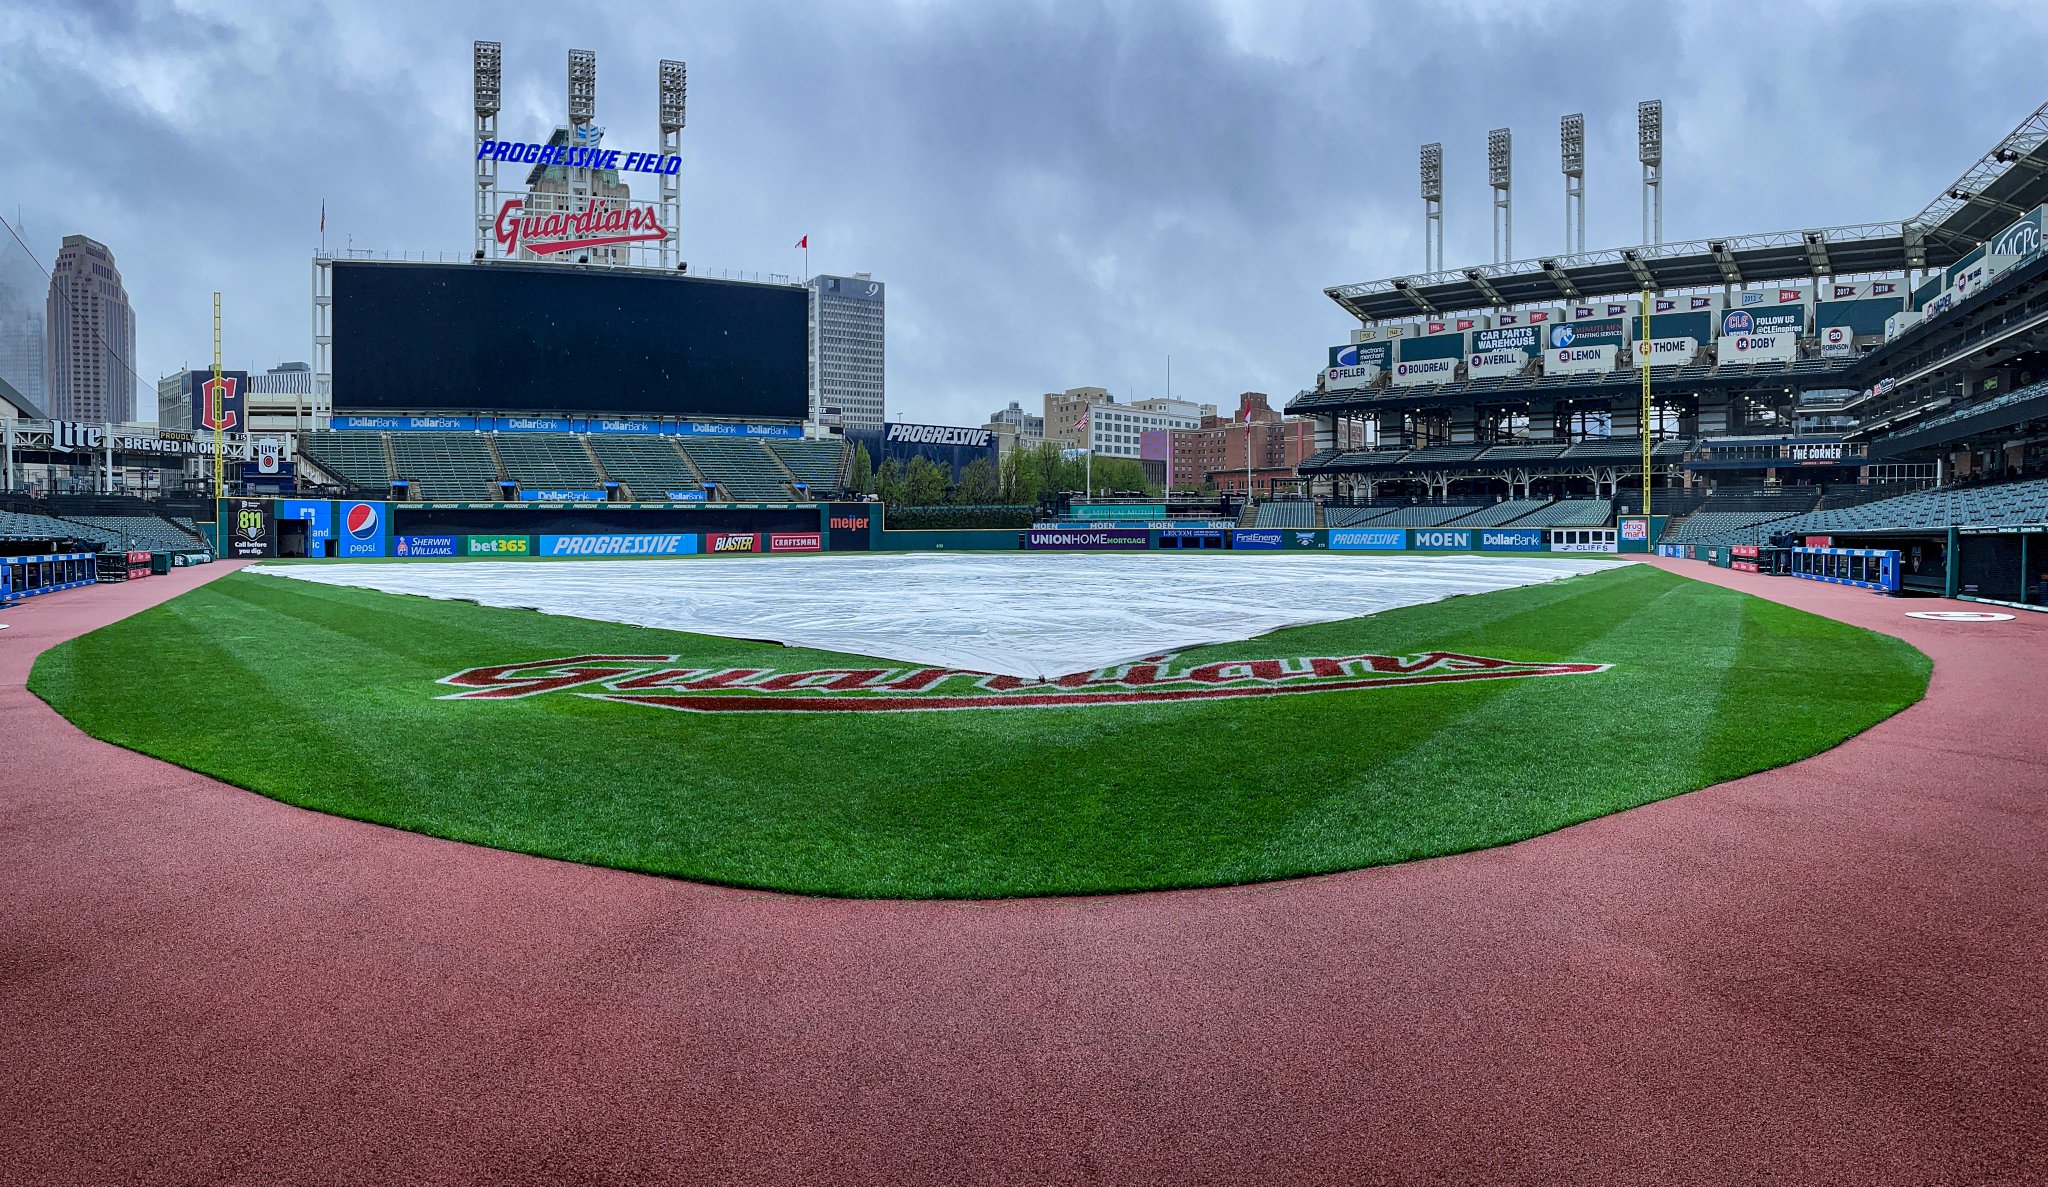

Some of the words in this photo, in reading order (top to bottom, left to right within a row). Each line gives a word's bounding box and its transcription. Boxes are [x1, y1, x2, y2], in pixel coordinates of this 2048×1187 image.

[477, 140, 621, 170] PROGRESSIVE
[623, 152, 683, 176] FIELD
[494, 199, 669, 257] Guardians
[865, 282, 879, 297] 9
[1781, 291, 1794, 300] 2016
[1836, 287, 1850, 296] 2017
[1657, 302, 1669, 310] 2001
[1692, 299, 1705, 307] 2007
[1728, 315, 1748, 328] CLE
[1756, 316, 1784, 326] FOLLOW
[1785, 315, 1795, 324] US
[1480, 331, 1500, 341] CAR
[1502, 328, 1533, 339] PARTS
[1478, 336, 1536, 350] WAREHOUSE
[1653, 340, 1686, 353] THOME
[1738, 340, 1747, 348] 14
[1750, 337, 1776, 348] DOBY
[1821, 343, 1849, 351] ROBINSON
[1360, 346, 1385, 355] electronic
[1571, 349, 1601, 361] LEMON
[1474, 357, 1479, 365] 3
[1483, 353, 1517, 366] AVERILL
[1339, 367, 1366, 379] FELLER
[1408, 361, 1449, 374] BOUDREAU
[202, 377, 237, 431] C
[50, 419, 102, 453] Lite
[160, 431, 195, 441] PROUDLY
[886, 423, 994, 448] PROGRESSIVE
[124, 437, 180, 452] BREWED
[182, 441, 196, 453] IN
[260, 444, 277, 456] Lite
[1793, 449, 1808, 460] THE
[1809, 447, 1841, 459] CORNER
[240, 511, 261, 529] 811
[830, 515, 869, 532] meijer
[1623, 520, 1643, 532] drug
[411, 537, 451, 546] SHERWIN
[774, 538, 818, 546] CRAFTSMAN
[1236, 533, 1282, 543] FirstEnergy
[1332, 533, 1401, 545] PROGRESSIVE
[1416, 533, 1467, 547] MOEN
[350, 543, 376, 554] pepsi
[470, 539, 527, 552] bet365
[552, 535, 681, 555] PROGRESSIVE
[1576, 544, 1608, 552] CLIFFS
